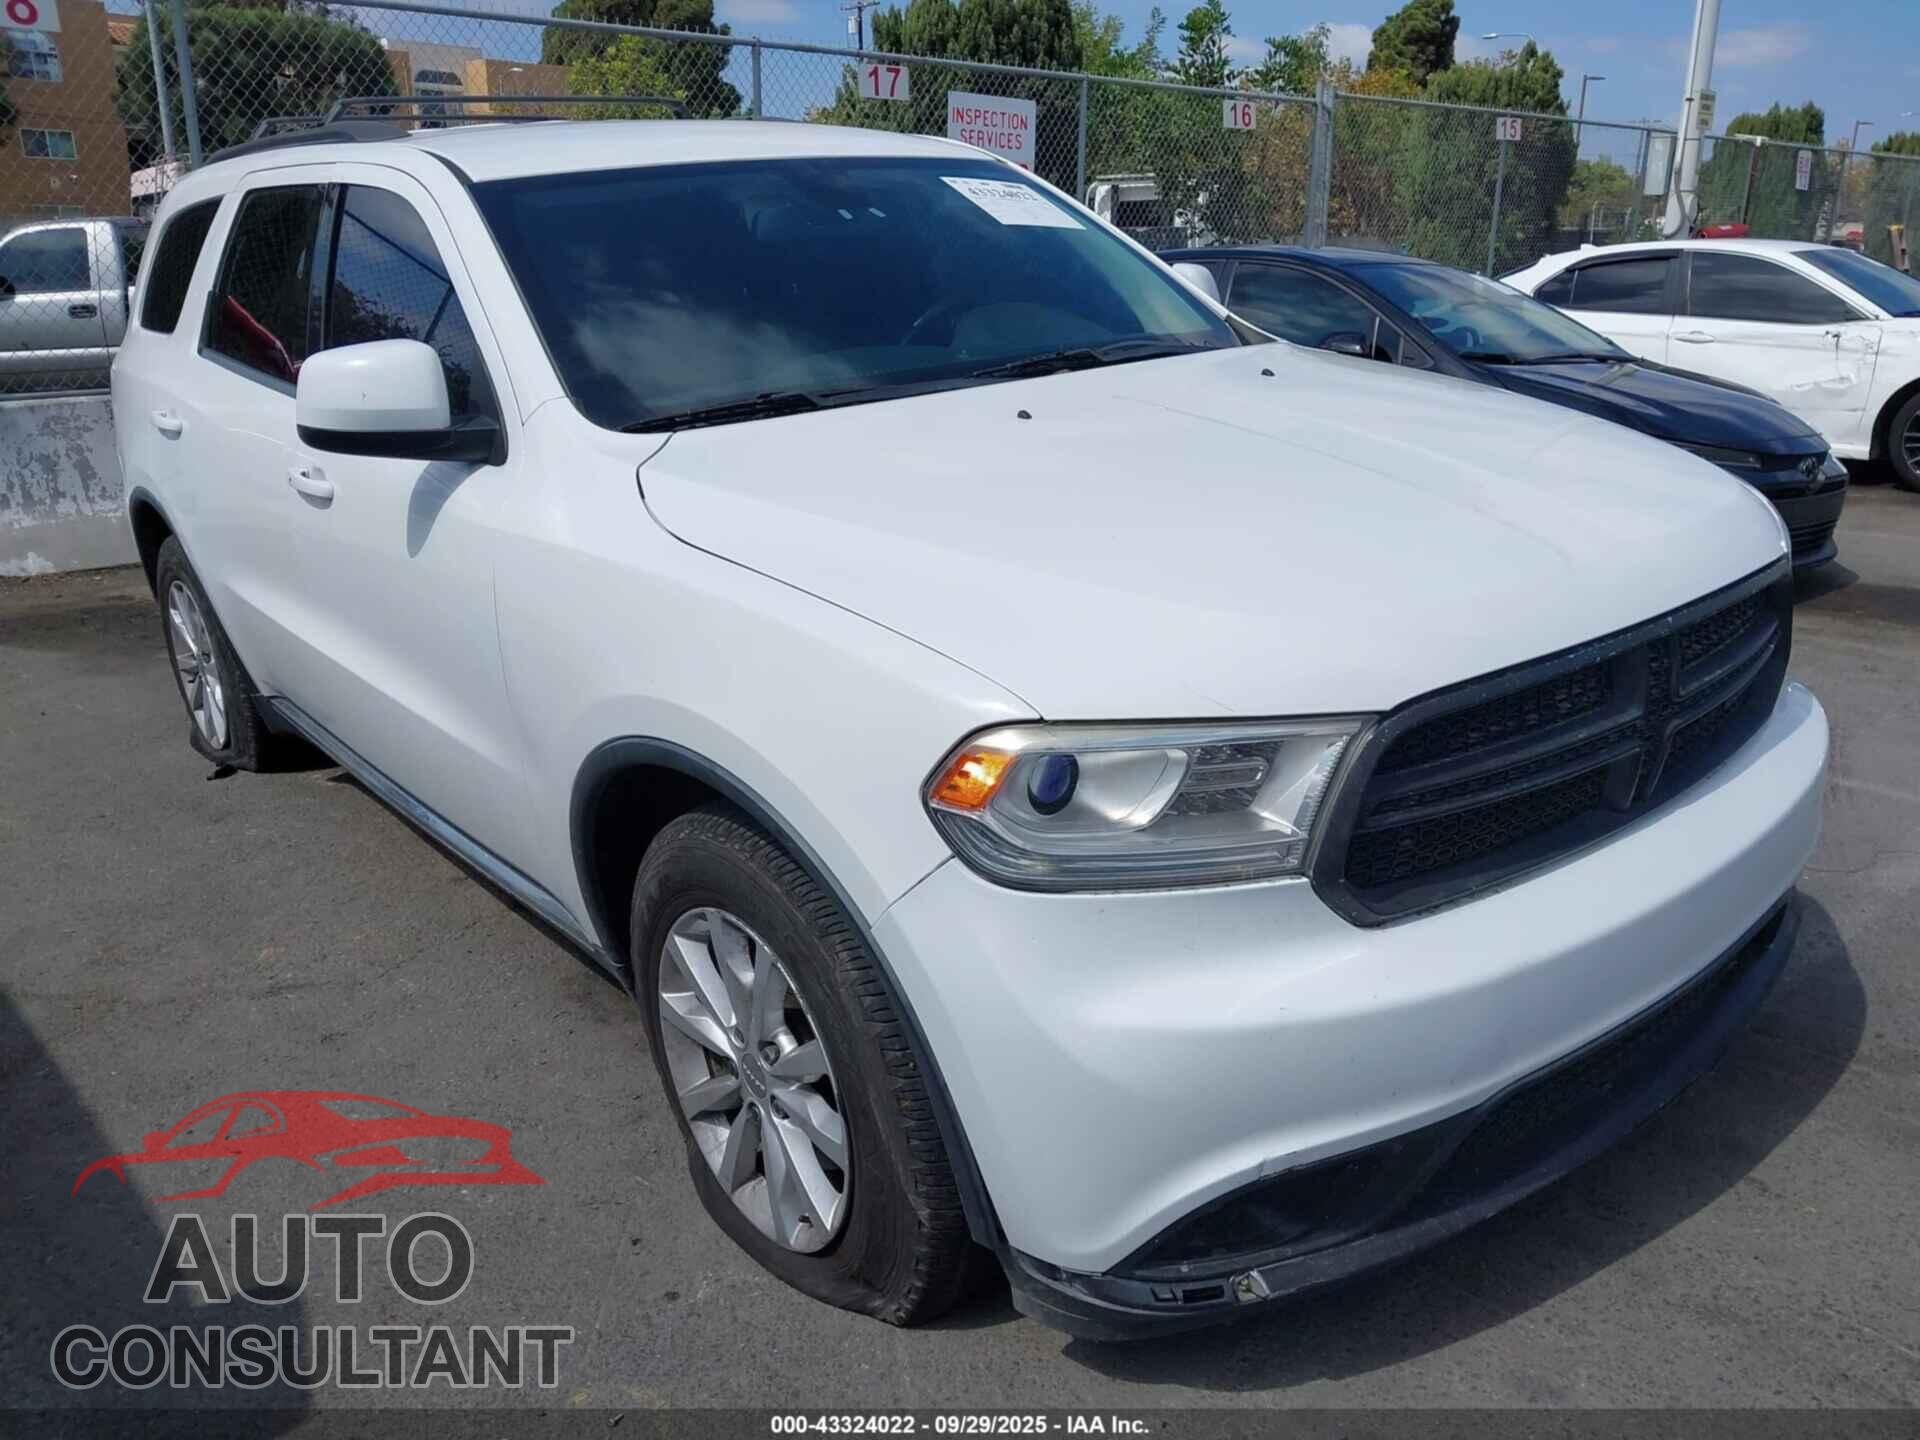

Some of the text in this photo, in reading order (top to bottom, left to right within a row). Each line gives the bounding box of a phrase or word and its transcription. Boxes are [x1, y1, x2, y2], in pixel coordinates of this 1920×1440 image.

[868, 66, 901, 97] 17
[952, 106, 1028, 131] INSPECTION
[1230, 103, 1252, 127] 16
[960, 128, 1023, 150] SERVICES
[1501, 119, 1517, 138] 15
